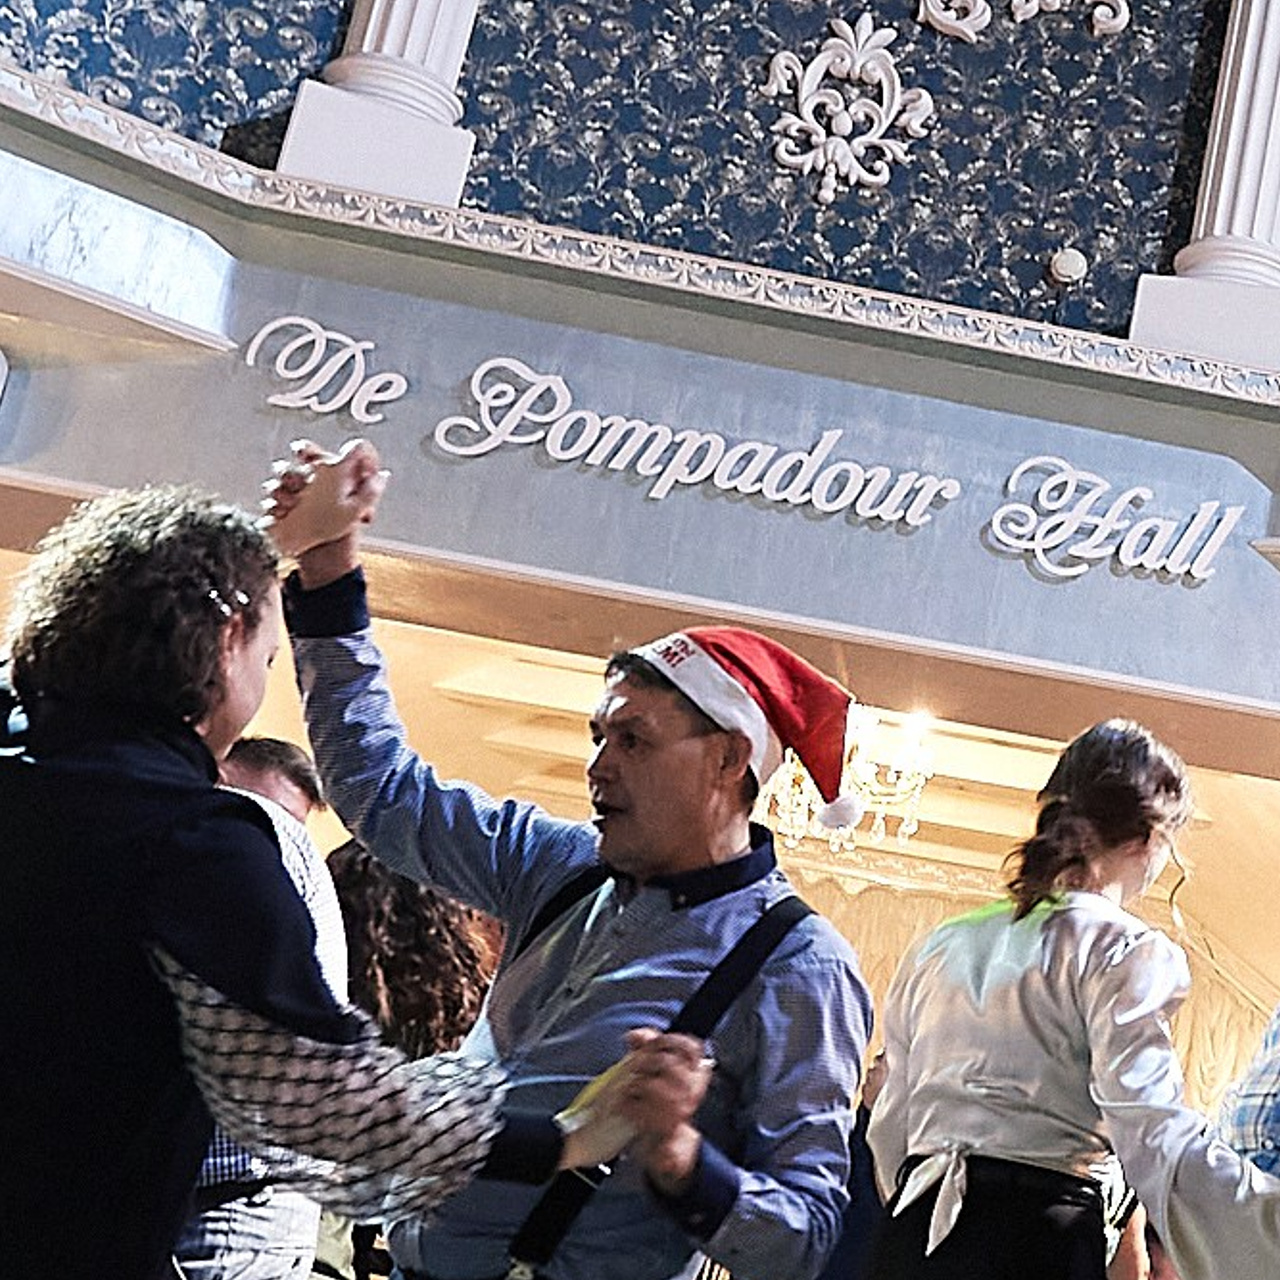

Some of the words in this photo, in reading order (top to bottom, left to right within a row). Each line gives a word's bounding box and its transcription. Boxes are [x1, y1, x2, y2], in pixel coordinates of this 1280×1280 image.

[246, 315, 408, 424] De
[434, 356, 961, 526] Pompadour
[991, 455, 1246, 581] Hall
